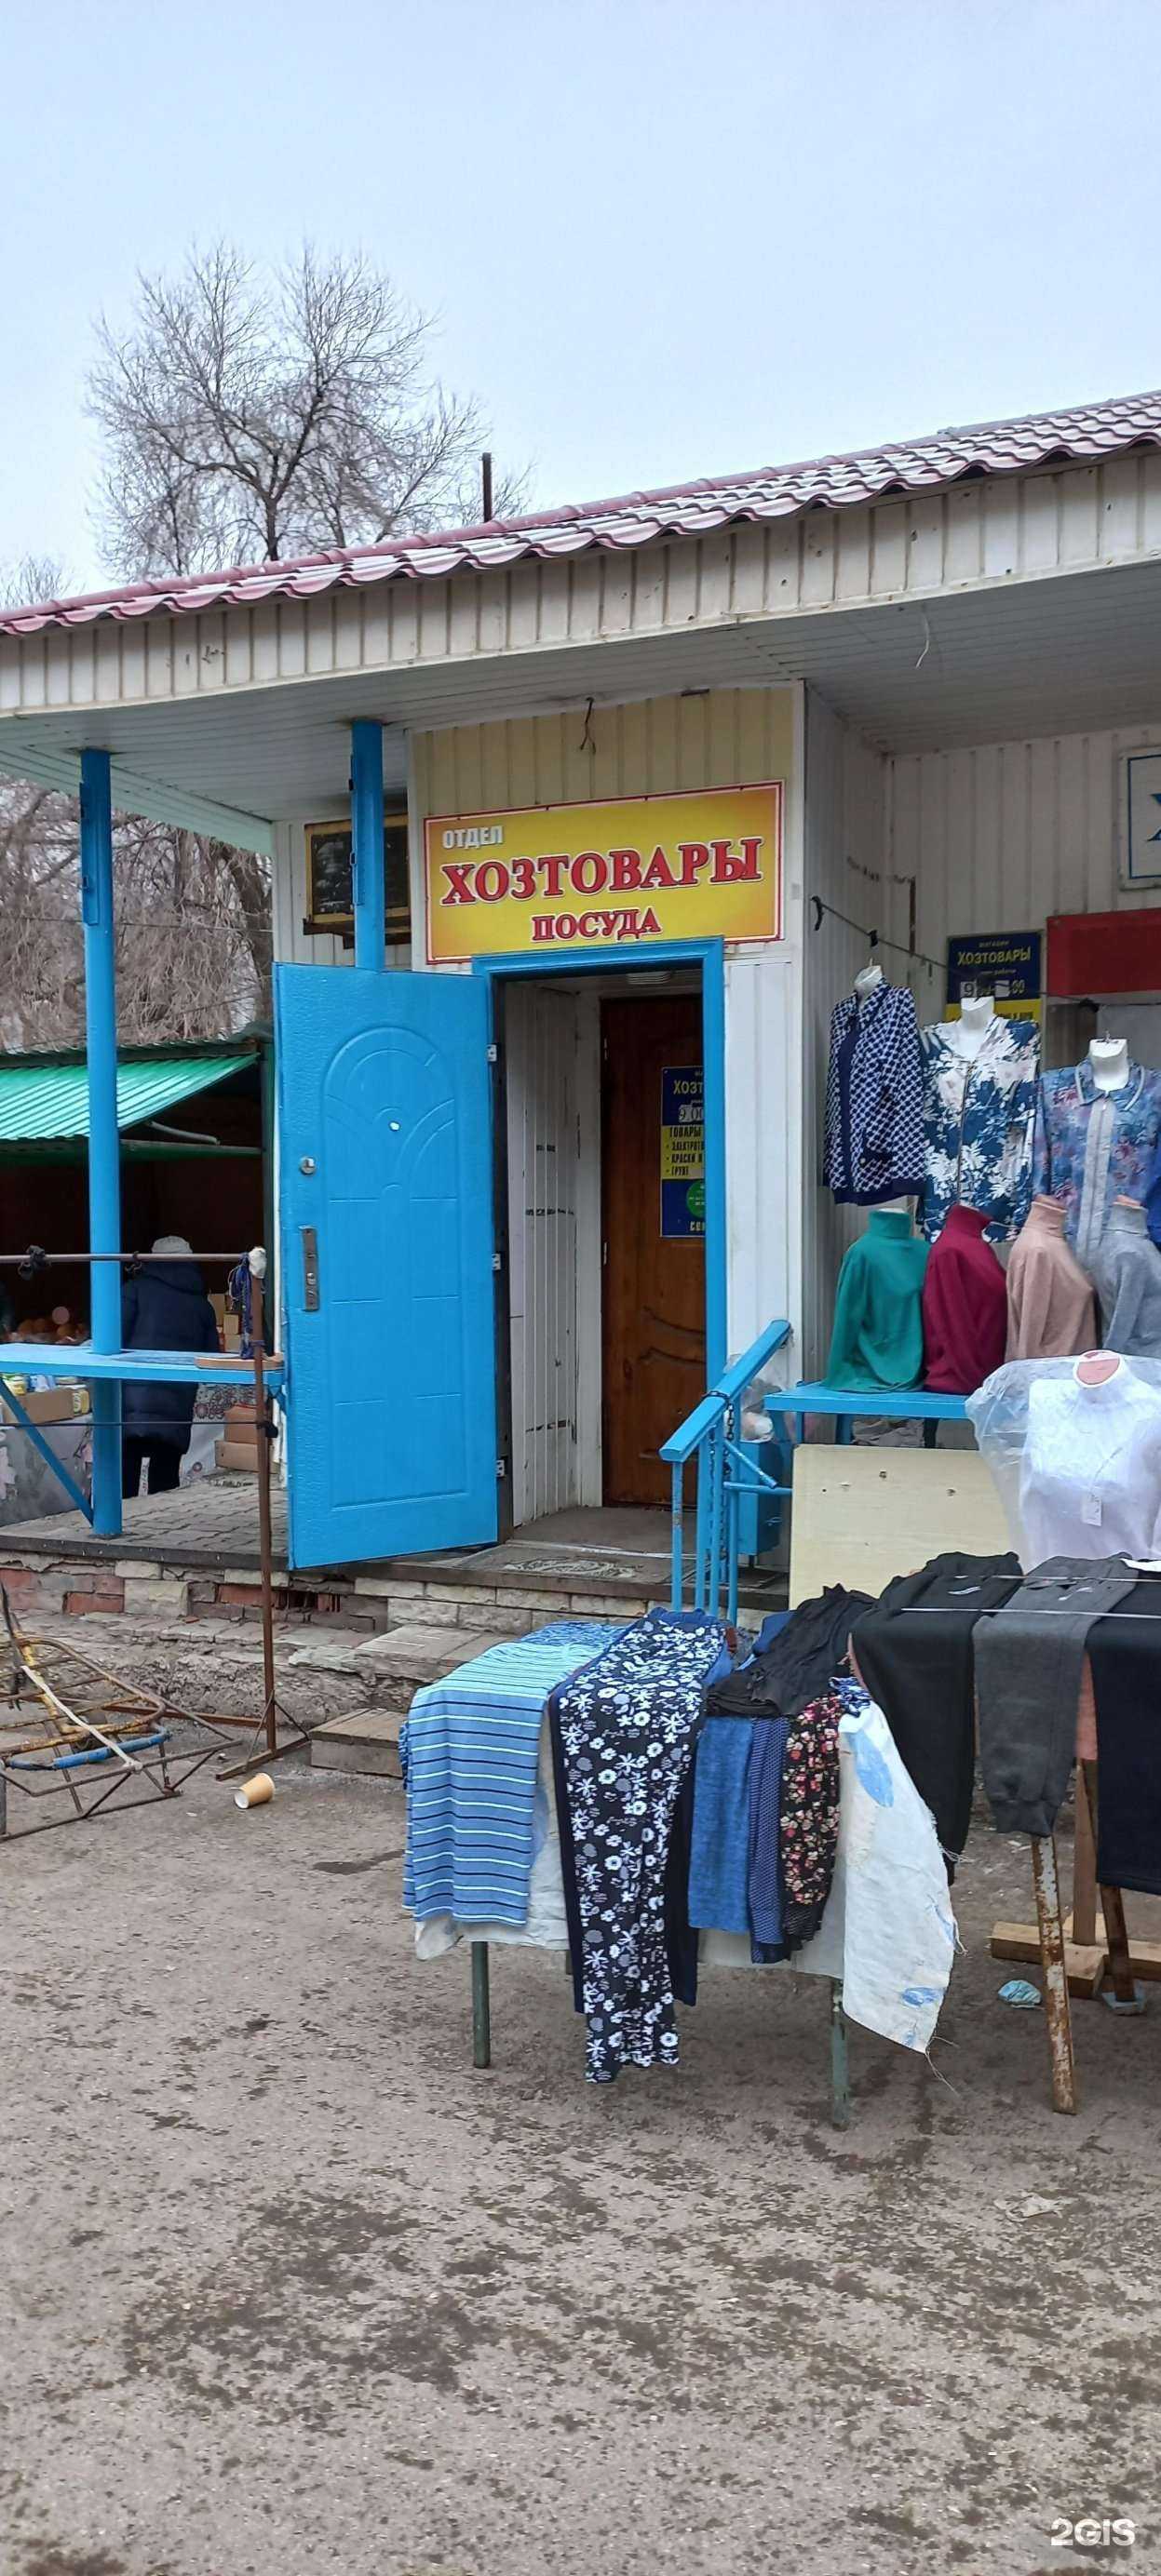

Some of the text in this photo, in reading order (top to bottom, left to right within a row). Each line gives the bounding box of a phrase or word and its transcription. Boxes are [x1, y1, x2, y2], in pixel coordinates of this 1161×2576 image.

[442, 825, 503, 850] ОТДЕЛ
[441, 838, 763, 905] ХОЗТОВАРЫ
[532, 906, 662, 941] ПОСУДА
[957, 946, 1032, 966] ХОЗТОВАРЫ
